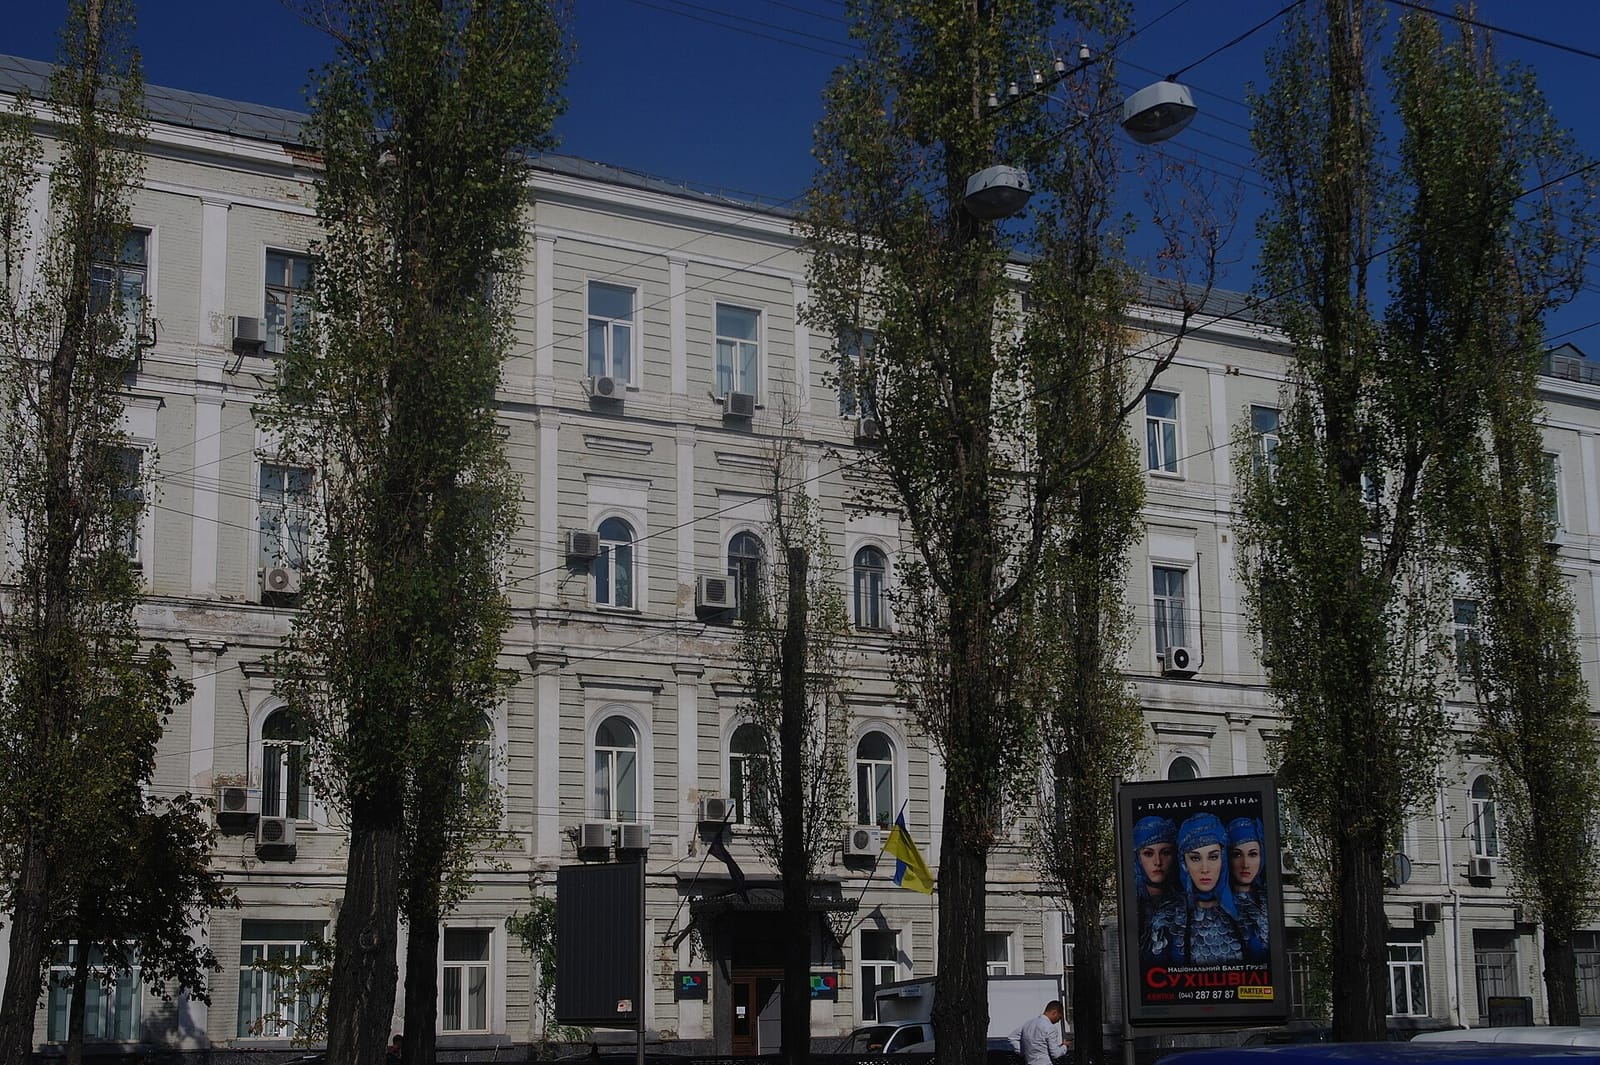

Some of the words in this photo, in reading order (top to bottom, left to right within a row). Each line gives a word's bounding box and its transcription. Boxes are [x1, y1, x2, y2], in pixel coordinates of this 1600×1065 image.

[1148, 799, 1192, 810] ПАЛАЦІ
[1178, 990, 1194, 1000] (044)
[1195, 990, 1210, 1000] 287
[1212, 990, 1222, 1000] 87
[1224, 990, 1235, 1000] 87
